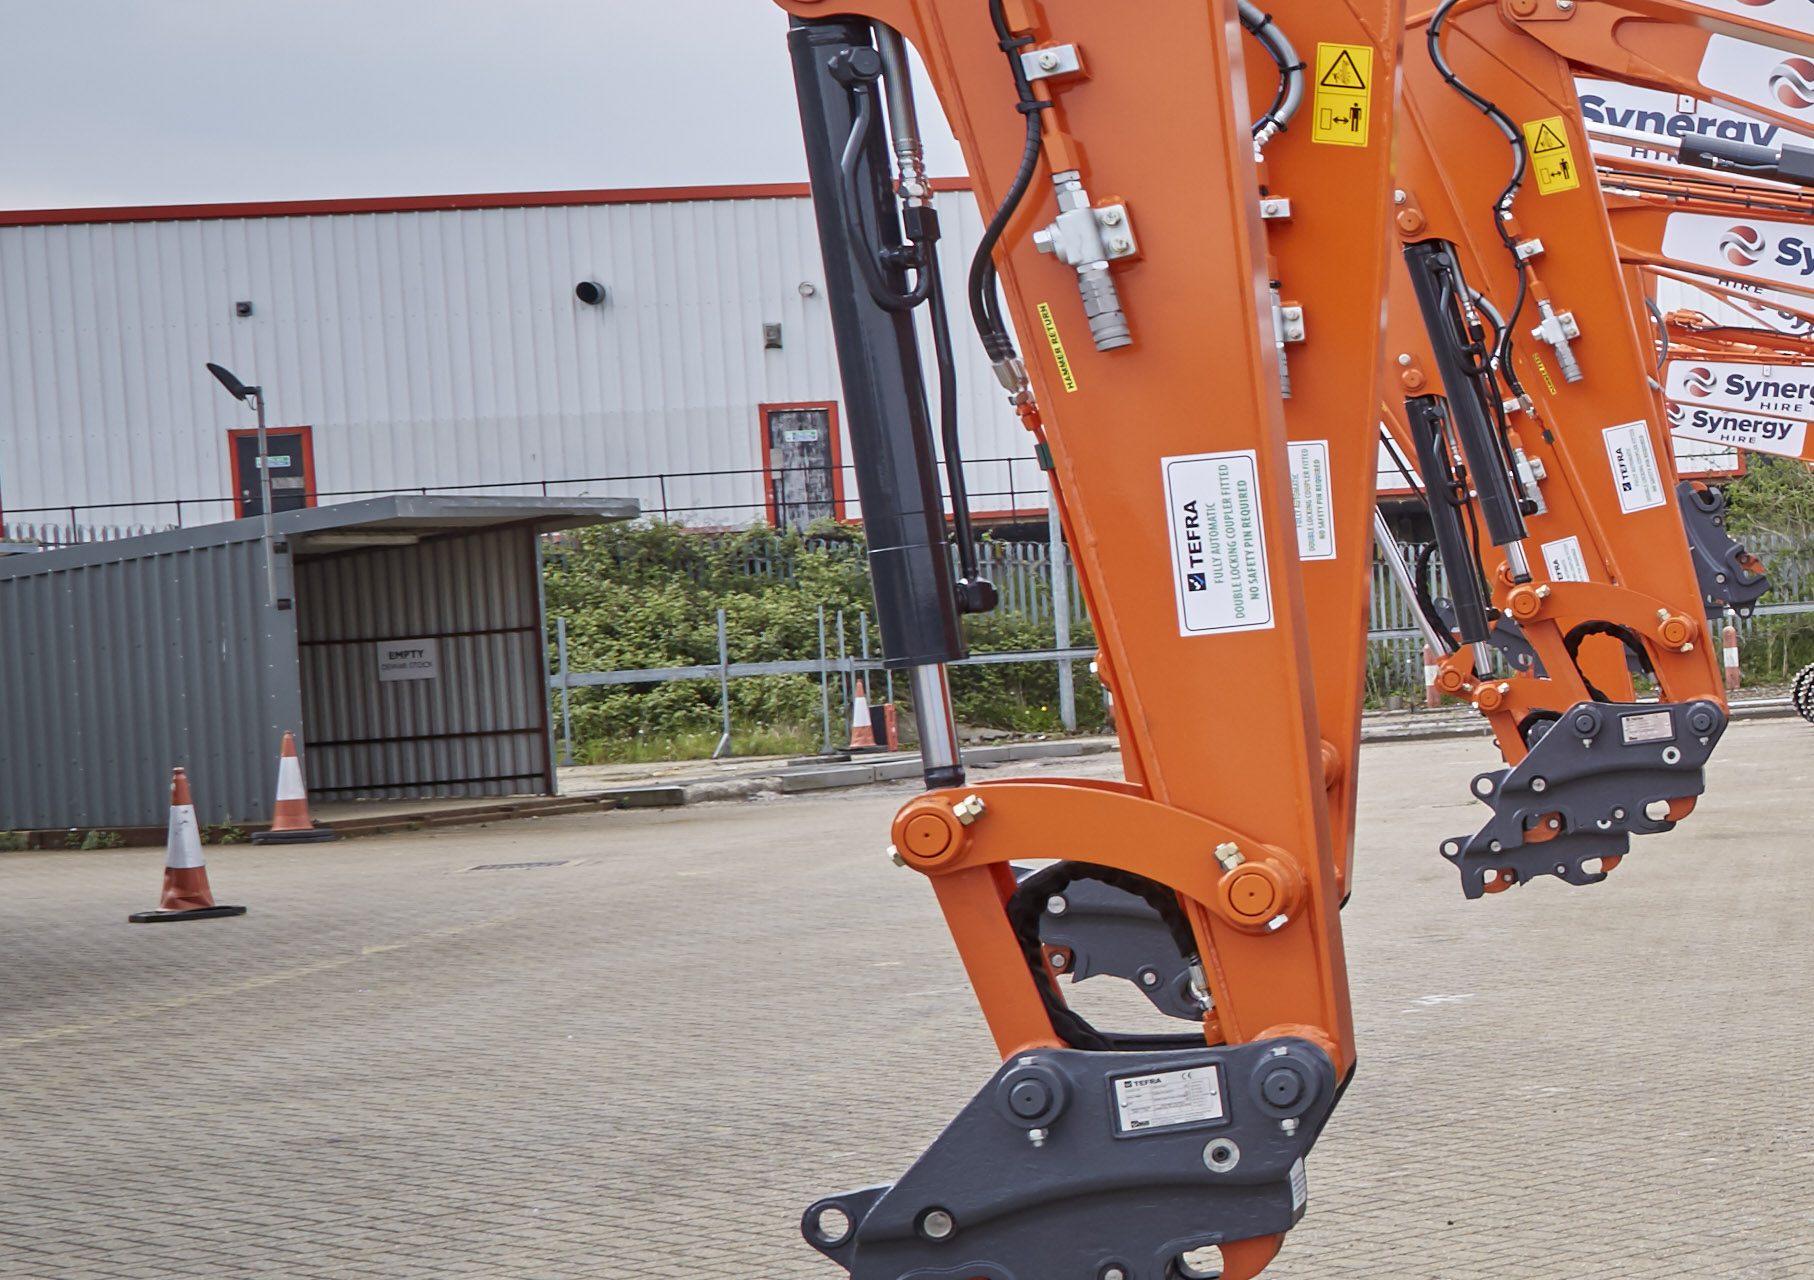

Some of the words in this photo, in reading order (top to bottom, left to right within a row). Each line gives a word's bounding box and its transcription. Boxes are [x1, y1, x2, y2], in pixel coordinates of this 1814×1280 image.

[1055, 348, 1074, 389] HAMMER
[1760, 401, 1803, 412] HIRE
[1693, 410, 1793, 440] Synergy
[1720, 434, 1756, 445] HIRE
[1218, 464, 1229, 494] FITTED
[1222, 497, 1235, 538] COUPLER
[1237, 480, 1252, 529] REQUIRED
[1183, 500, 1204, 568] TEFRA
[1205, 503, 1221, 554] AUTOMATIC
[1244, 531, 1254, 548] PIN
[1212, 557, 1224, 583] FULLY
[1227, 541, 1239, 580] LOCKING
[1247, 550, 1258, 584] SAFETY
[1232, 583, 1245, 618] DOUBLE
[1250, 587, 1260, 599] NO
[1134, 1078, 1162, 1087] TEFRA
